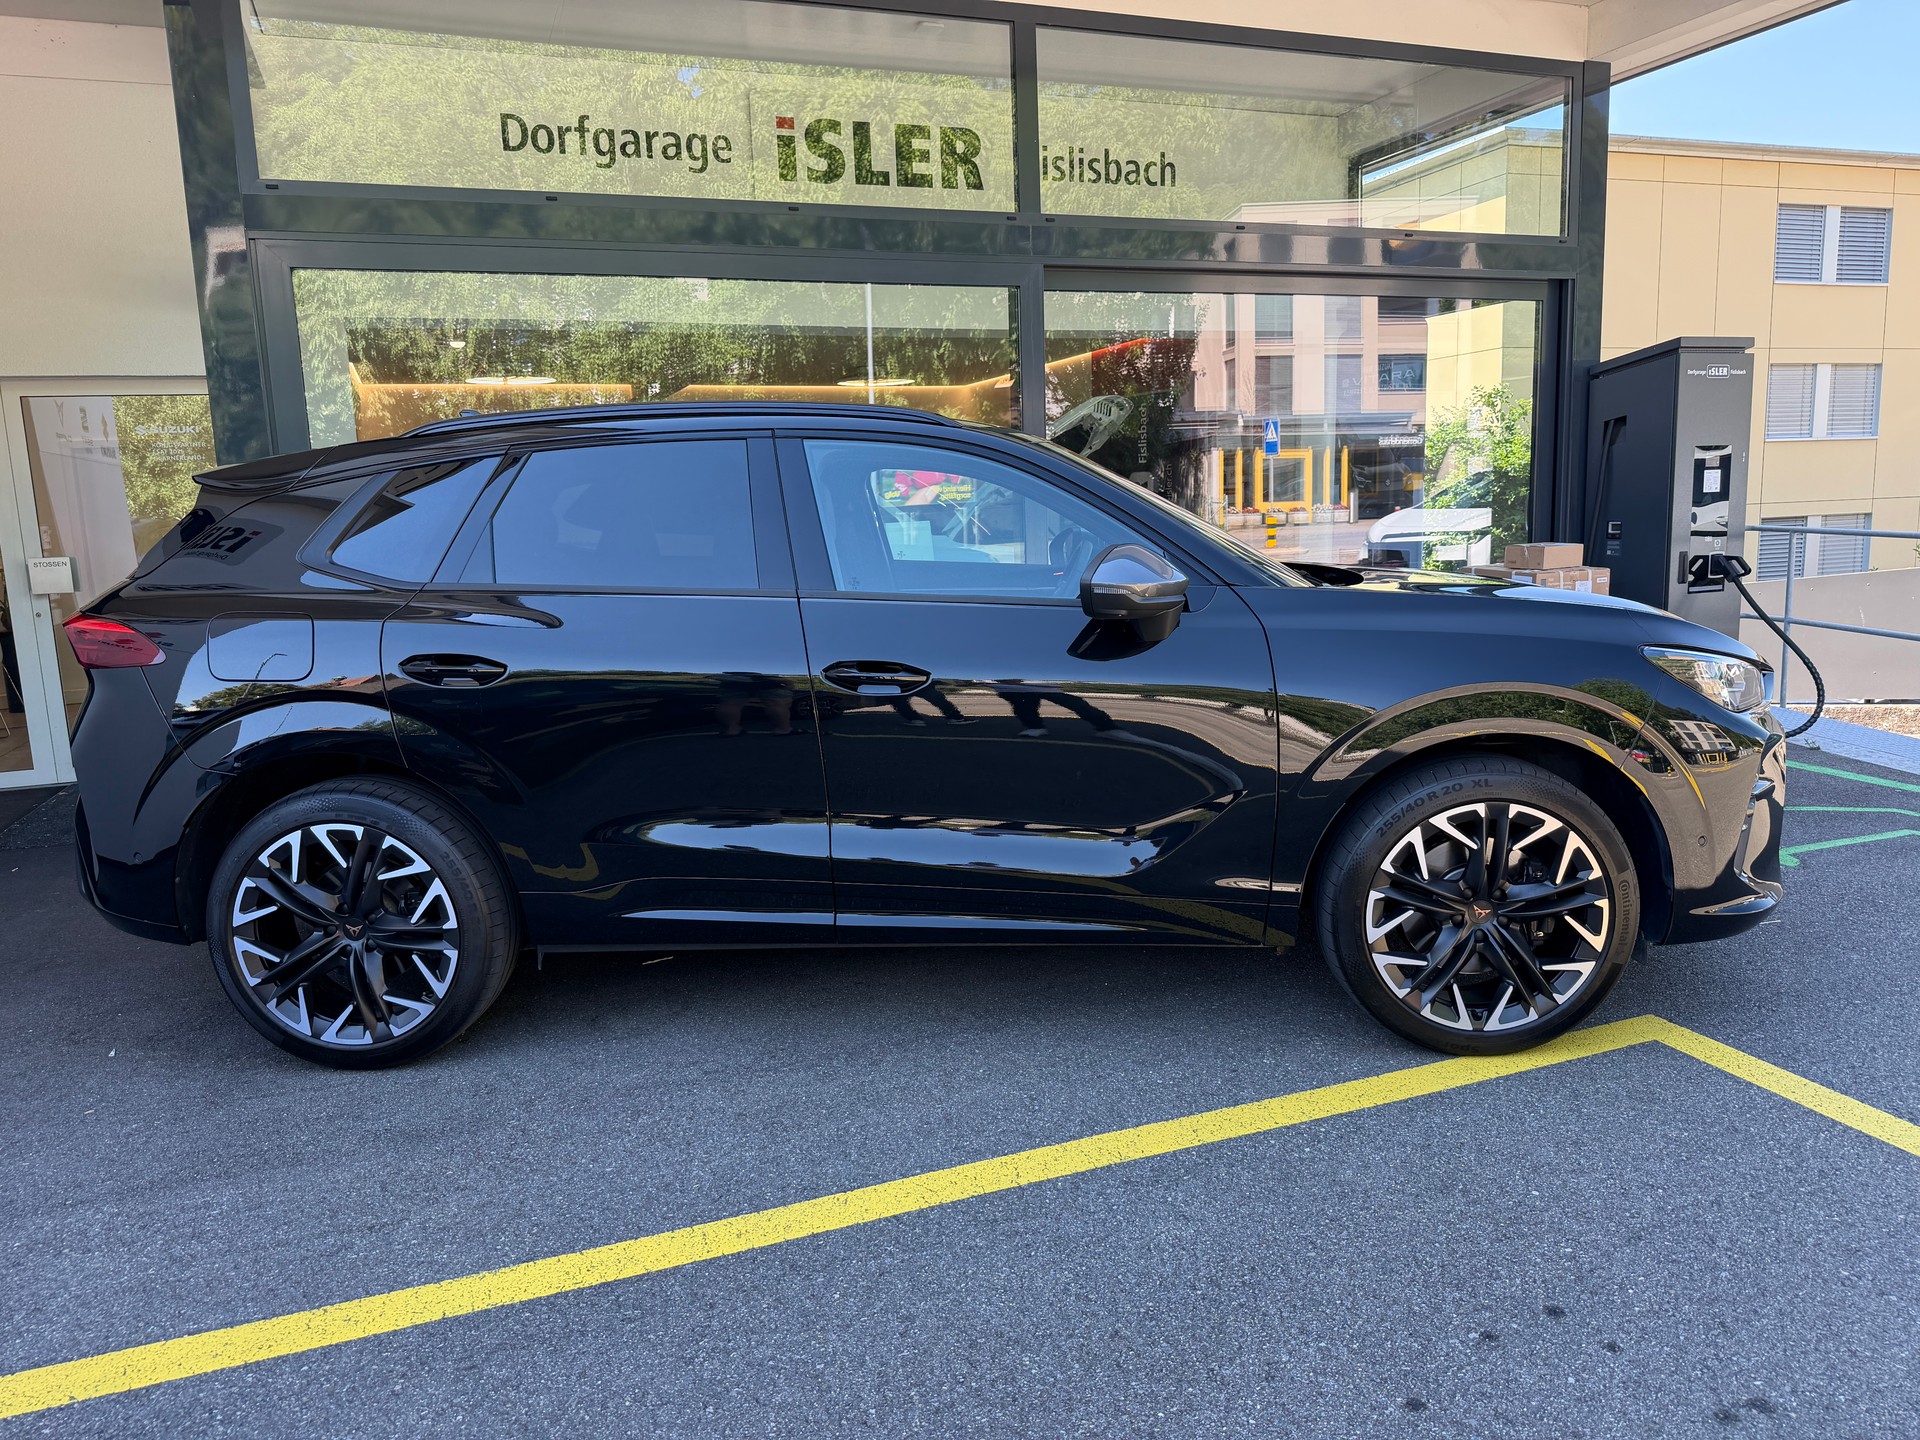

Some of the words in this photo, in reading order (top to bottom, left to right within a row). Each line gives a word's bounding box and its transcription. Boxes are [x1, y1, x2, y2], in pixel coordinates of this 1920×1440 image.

[499, 112, 733, 175] Dorfgarage
[775, 115, 985, 191] iSLER
[1041, 144, 1177, 188] islisbach
[1708, 367, 1728, 376] iSLER
[149, 425, 202, 434] SUZUKI
[1138, 402, 1148, 464] Fislisbach
[33, 560, 68, 569] STOSSEN
[1376, 797, 1426, 838] 255/40
[1426, 789, 1441, 802] R
[1441, 782, 1465, 796] 20
[1471, 777, 1494, 790] XL
[1618, 878, 1633, 946] Continental
